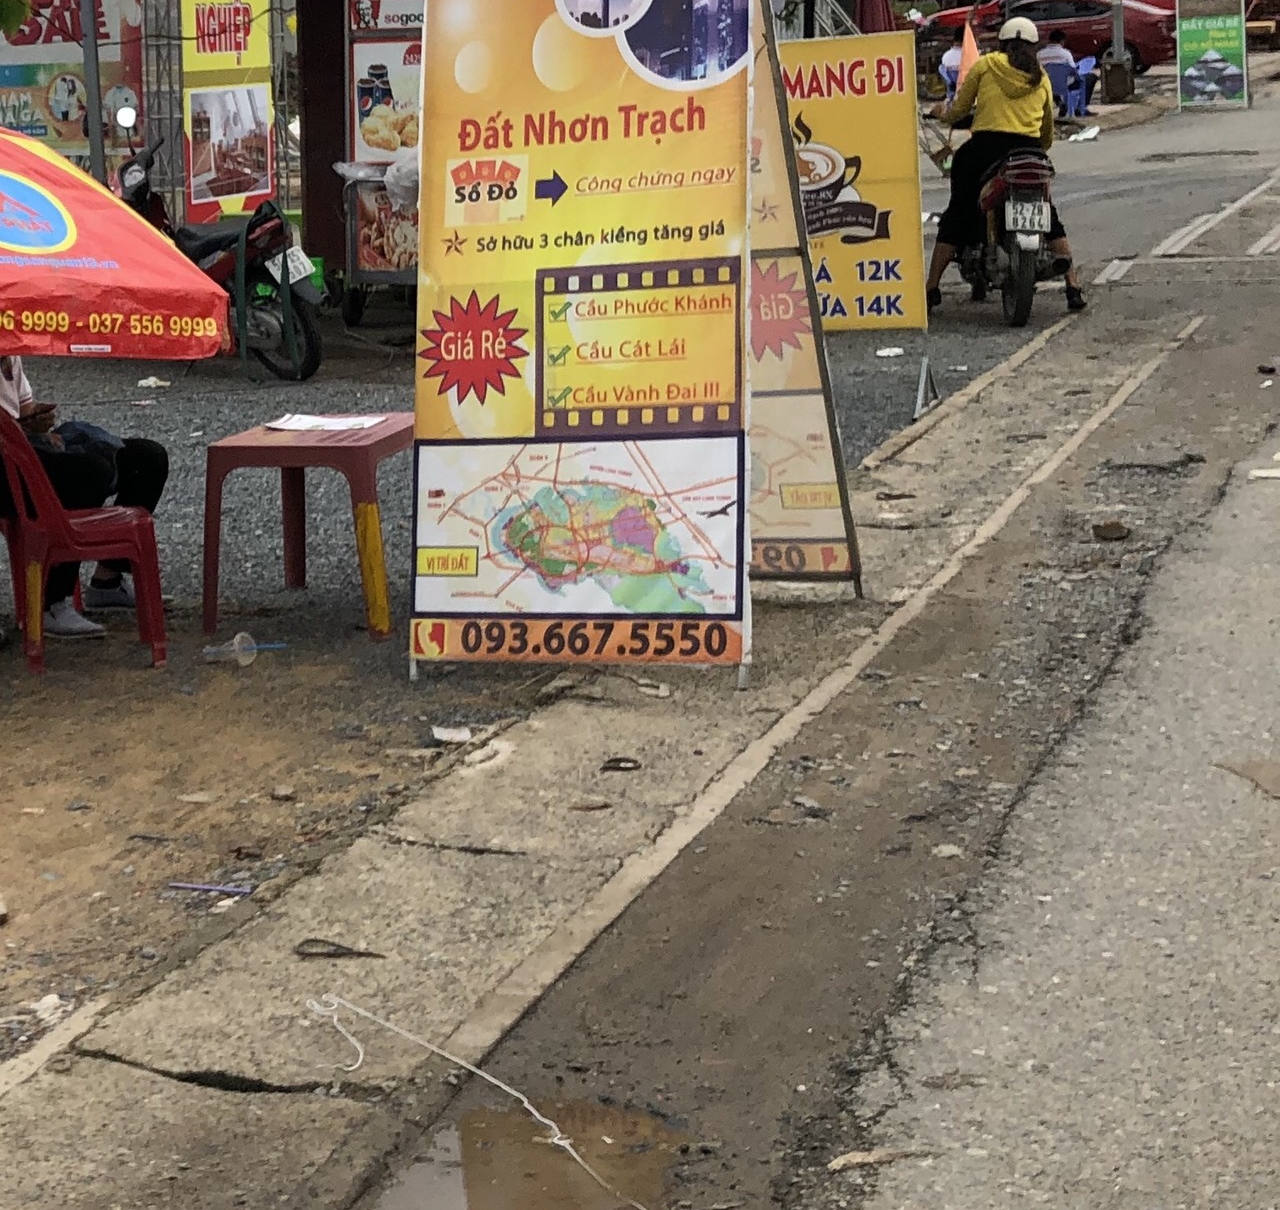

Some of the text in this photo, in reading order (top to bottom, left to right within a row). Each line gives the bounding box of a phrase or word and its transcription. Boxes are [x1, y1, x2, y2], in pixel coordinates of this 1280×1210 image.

[384, 13, 424, 26] sogoo
[782, 56, 904, 100] MANG ĐI
[458, 95, 706, 152] Đất Nhơn Trạch
[487, 180, 518, 202] Đỏ
[576, 175, 622, 194] Công
[628, 168, 685, 191] chứng
[690, 165, 737, 187] ngay
[501, 234, 534, 251] hữu
[539, 233, 549, 249] 3
[553, 230, 595, 248] chân
[653, 223, 694, 243] tăng
[698, 218, 725, 241] giá
[855, 259, 903, 283] 12K
[613, 297, 669, 315] Phước
[674, 292, 732, 312] Khánh
[854, 294, 904, 318] 14K
[21, 310, 70, 333] 9999
[88, 312, 124, 334] 037
[130, 315, 164, 336] 556
[169, 316, 218, 338] 9999
[441, 327, 507, 361] Giá Rẻ
[619, 339, 651, 359] Cát
[658, 338, 686, 357] Lái
[612, 384, 660, 403] Vành
[703, 381, 720, 399] III
[437, 555, 449, 571] TRÍ
[460, 619, 728, 657] 093.667.5550
